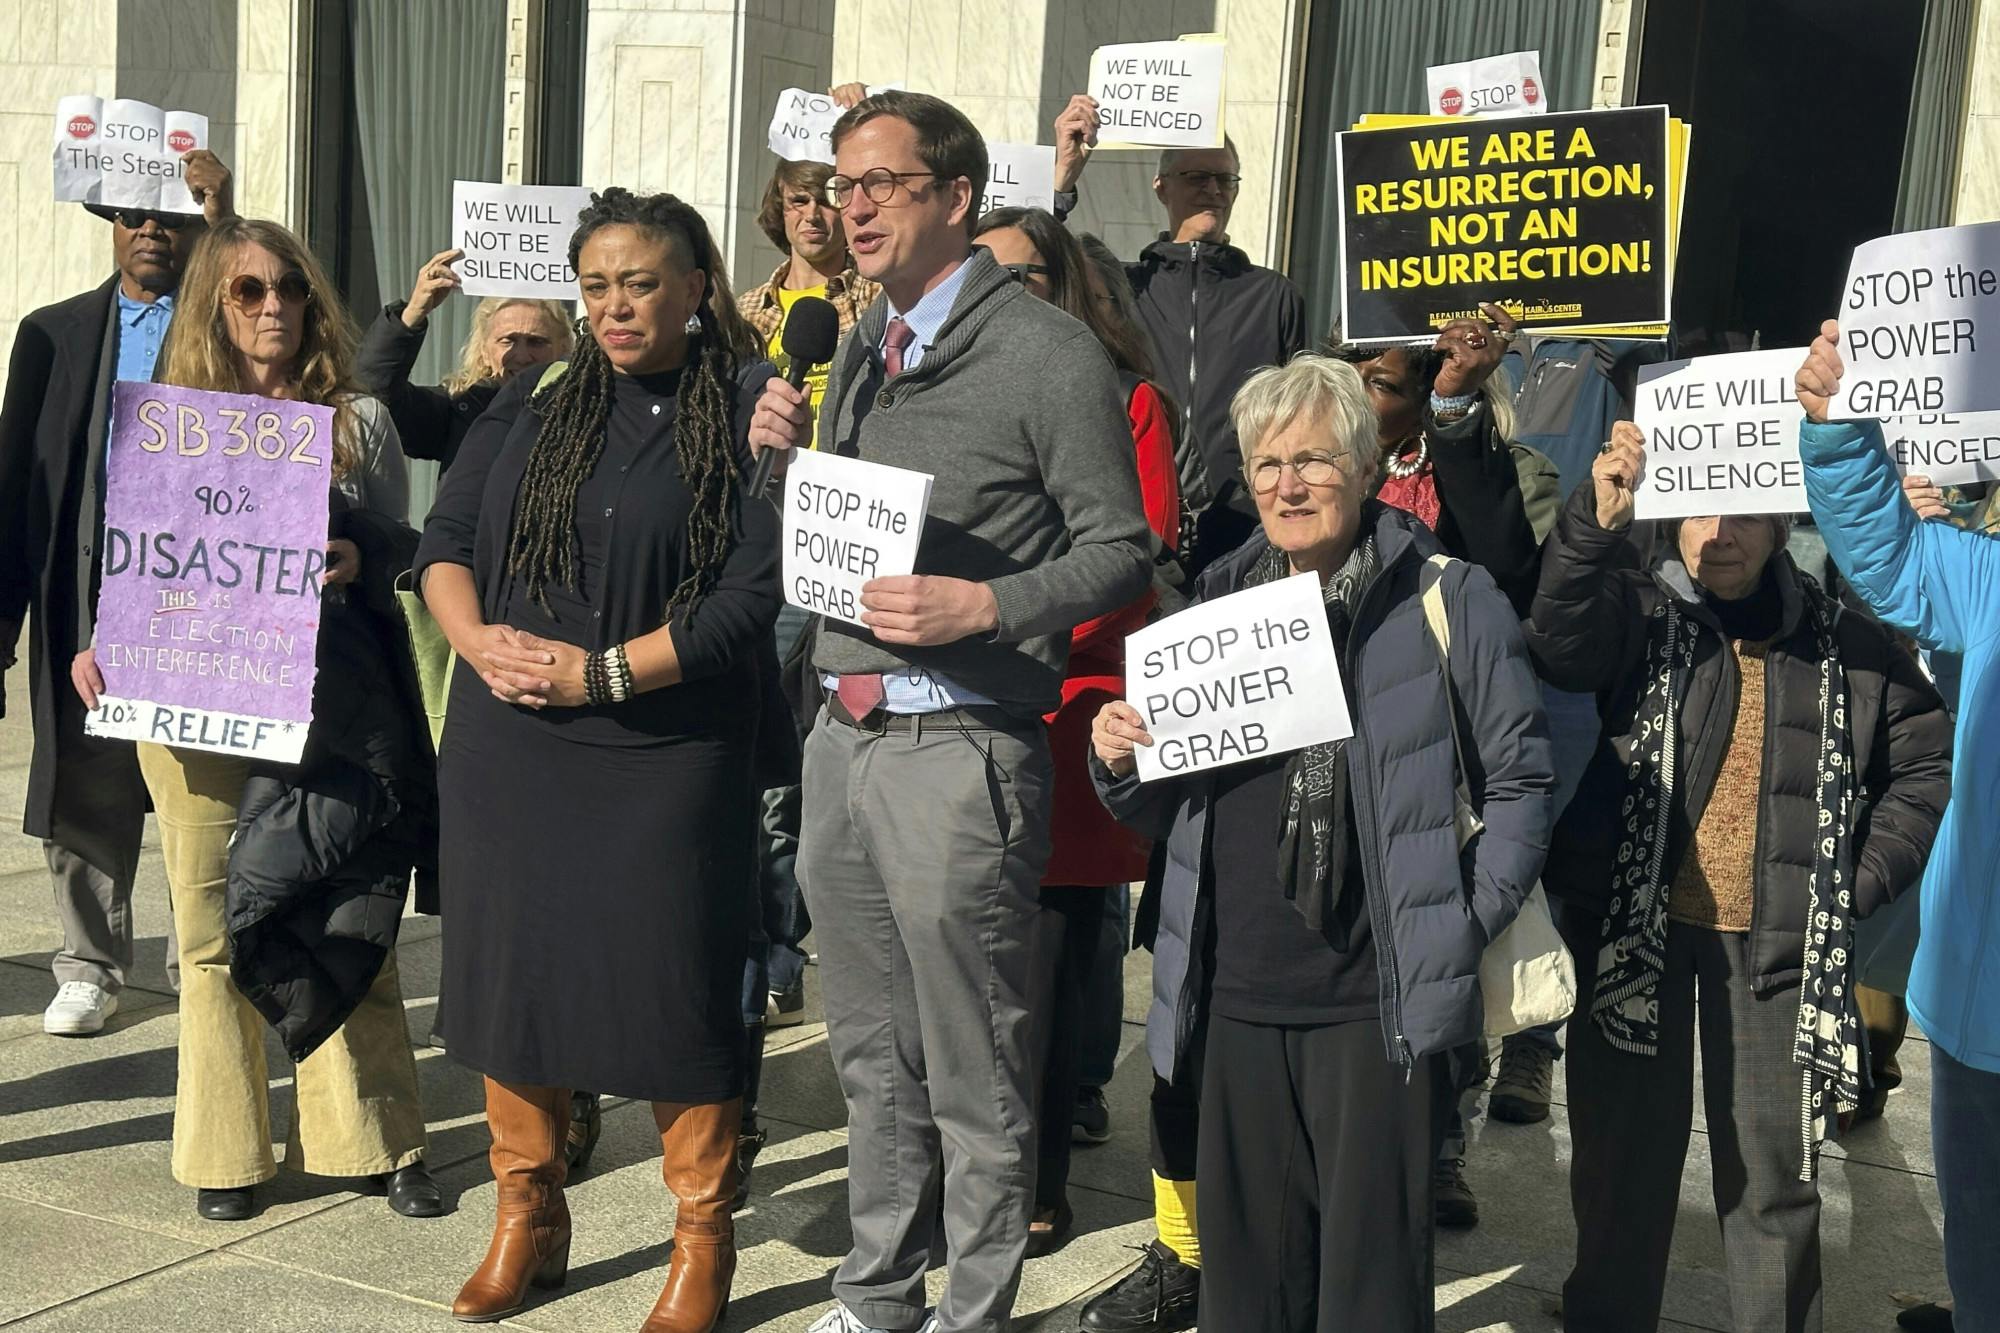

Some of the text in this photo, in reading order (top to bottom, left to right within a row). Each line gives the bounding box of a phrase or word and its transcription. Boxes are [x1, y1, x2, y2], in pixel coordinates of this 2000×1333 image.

[1107, 59, 1192, 77] WE WILL
[791, 95, 831, 112] NO
[1102, 83, 1180, 102] NOT BE
[1442, 96, 1462, 108] STOP
[1470, 84, 1516, 108] STOP
[69, 123, 94, 131] STOP
[105, 123, 159, 142] STOP
[1100, 107, 1202, 131] SILENCED
[169, 136, 194, 146] STOP
[1410, 127, 1596, 171] WE ARE A
[68, 148, 182, 178] The Steal
[986, 162, 1020, 185] ILL
[1356, 163, 1654, 215] RESURRECTION,
[465, 200, 561, 224] WE WILL
[1430, 207, 1577, 247] NOT AN
[464, 230, 549, 253] NOT BE
[464, 259, 579, 283] SILENCED
[1361, 240, 1651, 291] INSURRECTION!
[1849, 264, 1997, 310] STOP the
[1554, 303, 1582, 313] CENTER
[1847, 318, 1976, 361] POWER
[1654, 377, 1799, 412] WE WILL
[1849, 376, 1945, 413] GRAB
[137, 399, 322, 466] SB 382
[1653, 420, 1781, 452] NOT BE
[1895, 437, 2000, 465] ENCED
[1654, 461, 1801, 493] SILENCE
[194, 485, 254, 515] 90%
[797, 481, 907, 535] STOP the
[105, 527, 325, 599] DISASTER
[795, 528, 880, 579] POWER
[157, 590, 231, 608] THIS IS
[795, 576, 856, 620] GRAB
[149, 617, 295, 656] ELECTION
[1143, 617, 1311, 679] STOP the
[107, 644, 294, 687] INTERFERENCE
[1146, 666, 1294, 726] POWER
[98, 703, 276, 750] 10% RELIEF
[1158, 722, 1269, 771] GRAB
